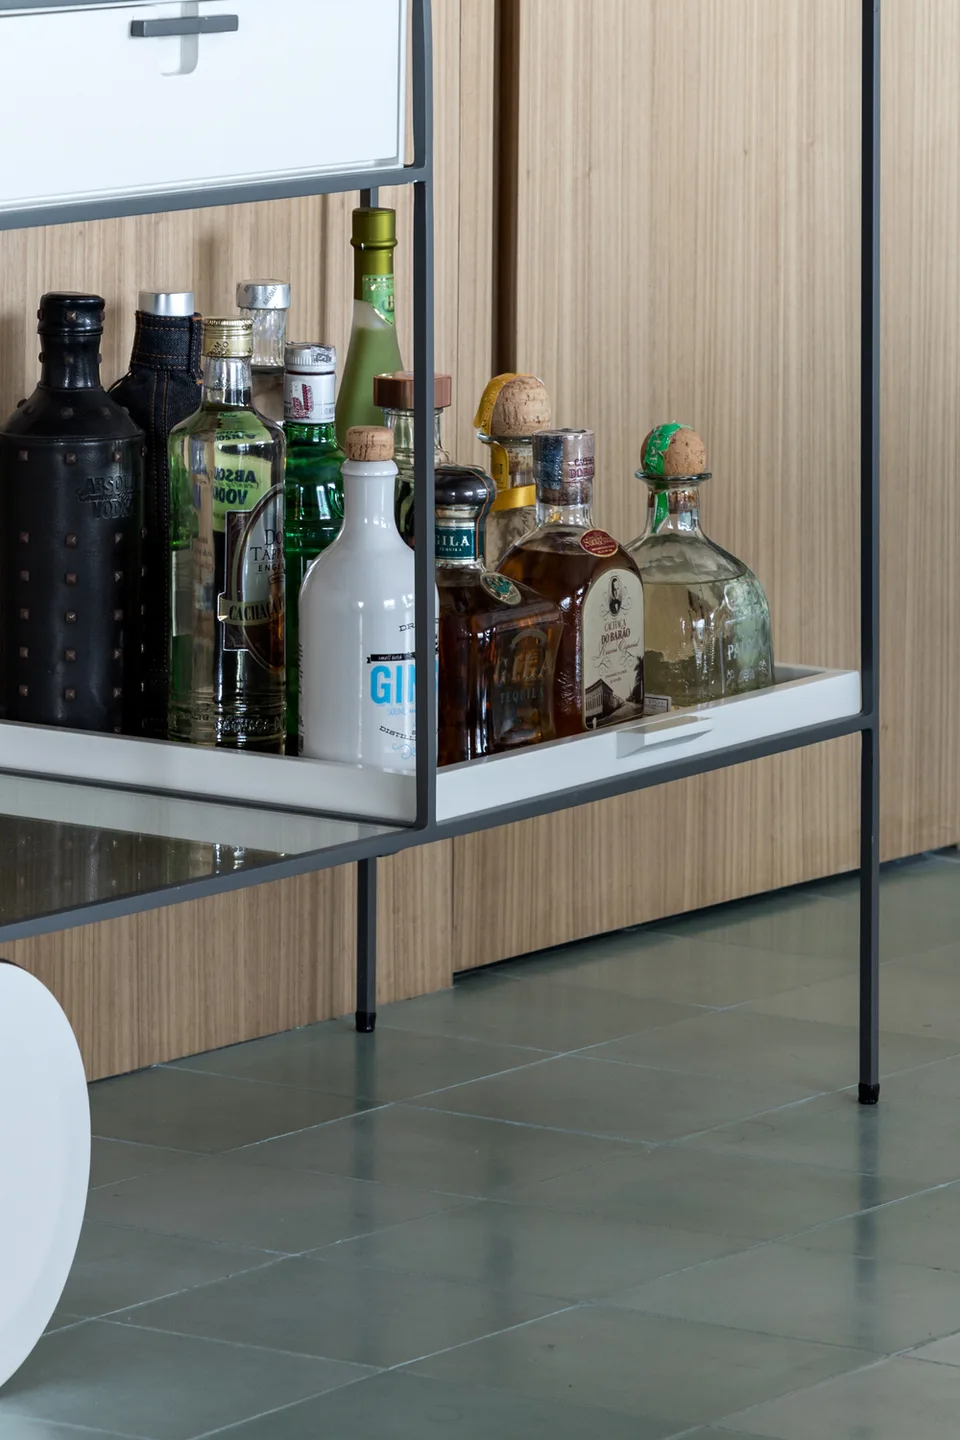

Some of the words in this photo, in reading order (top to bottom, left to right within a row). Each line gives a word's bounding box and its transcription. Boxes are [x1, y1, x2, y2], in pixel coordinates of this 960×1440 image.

[265, 529, 283, 546] DO
[398, 622, 416, 632] DR
[379, 724, 416, 742] DISTILL
